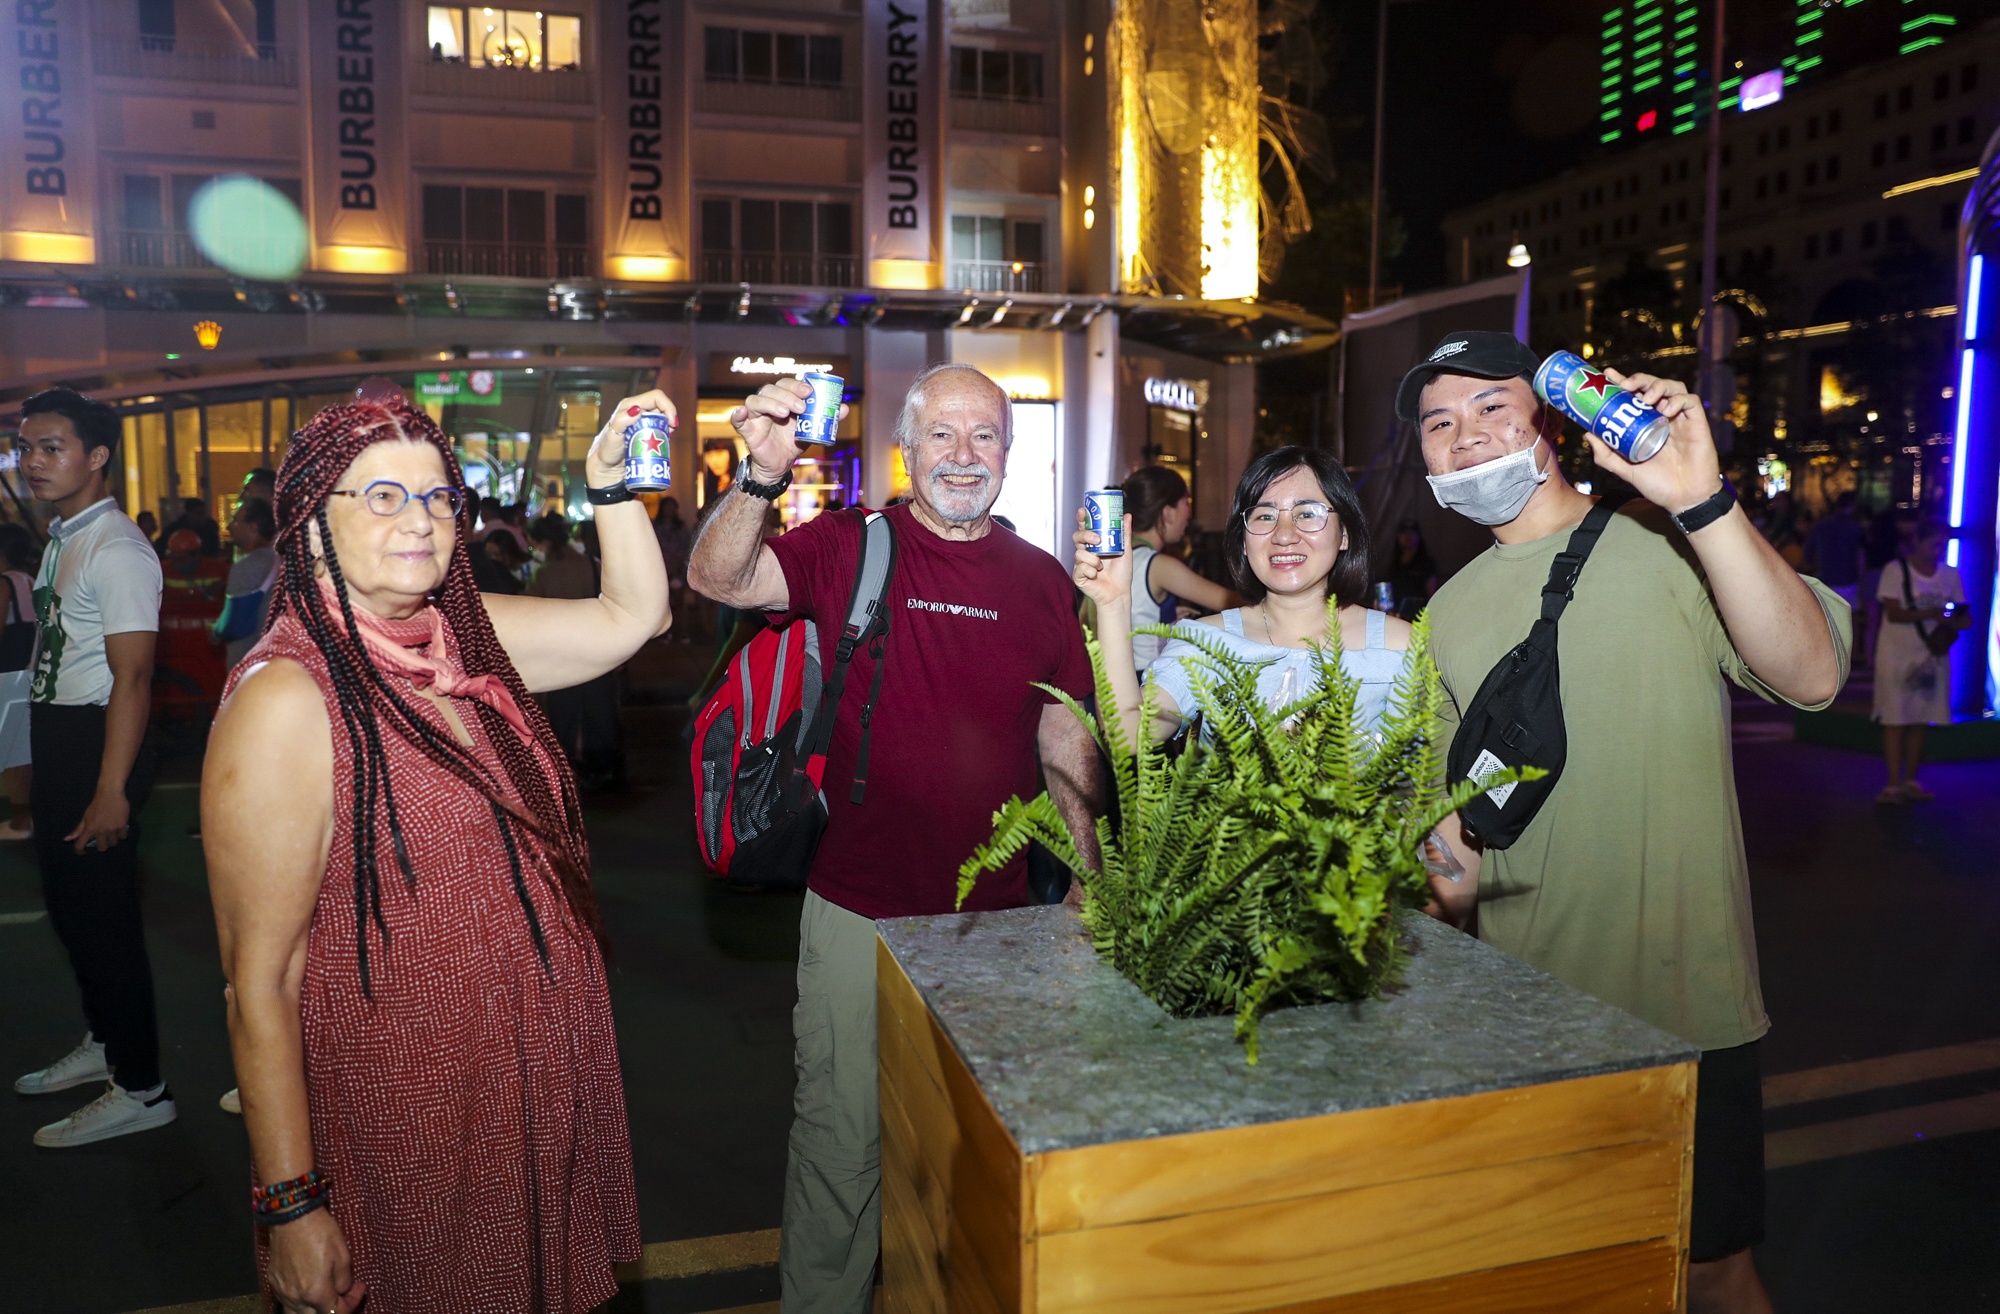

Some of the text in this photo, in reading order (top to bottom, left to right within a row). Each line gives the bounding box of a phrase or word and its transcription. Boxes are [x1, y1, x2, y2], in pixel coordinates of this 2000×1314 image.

[887, 1, 919, 230] BURBERRY
[907, 598, 998, 621] EMPORIO ARMANI
